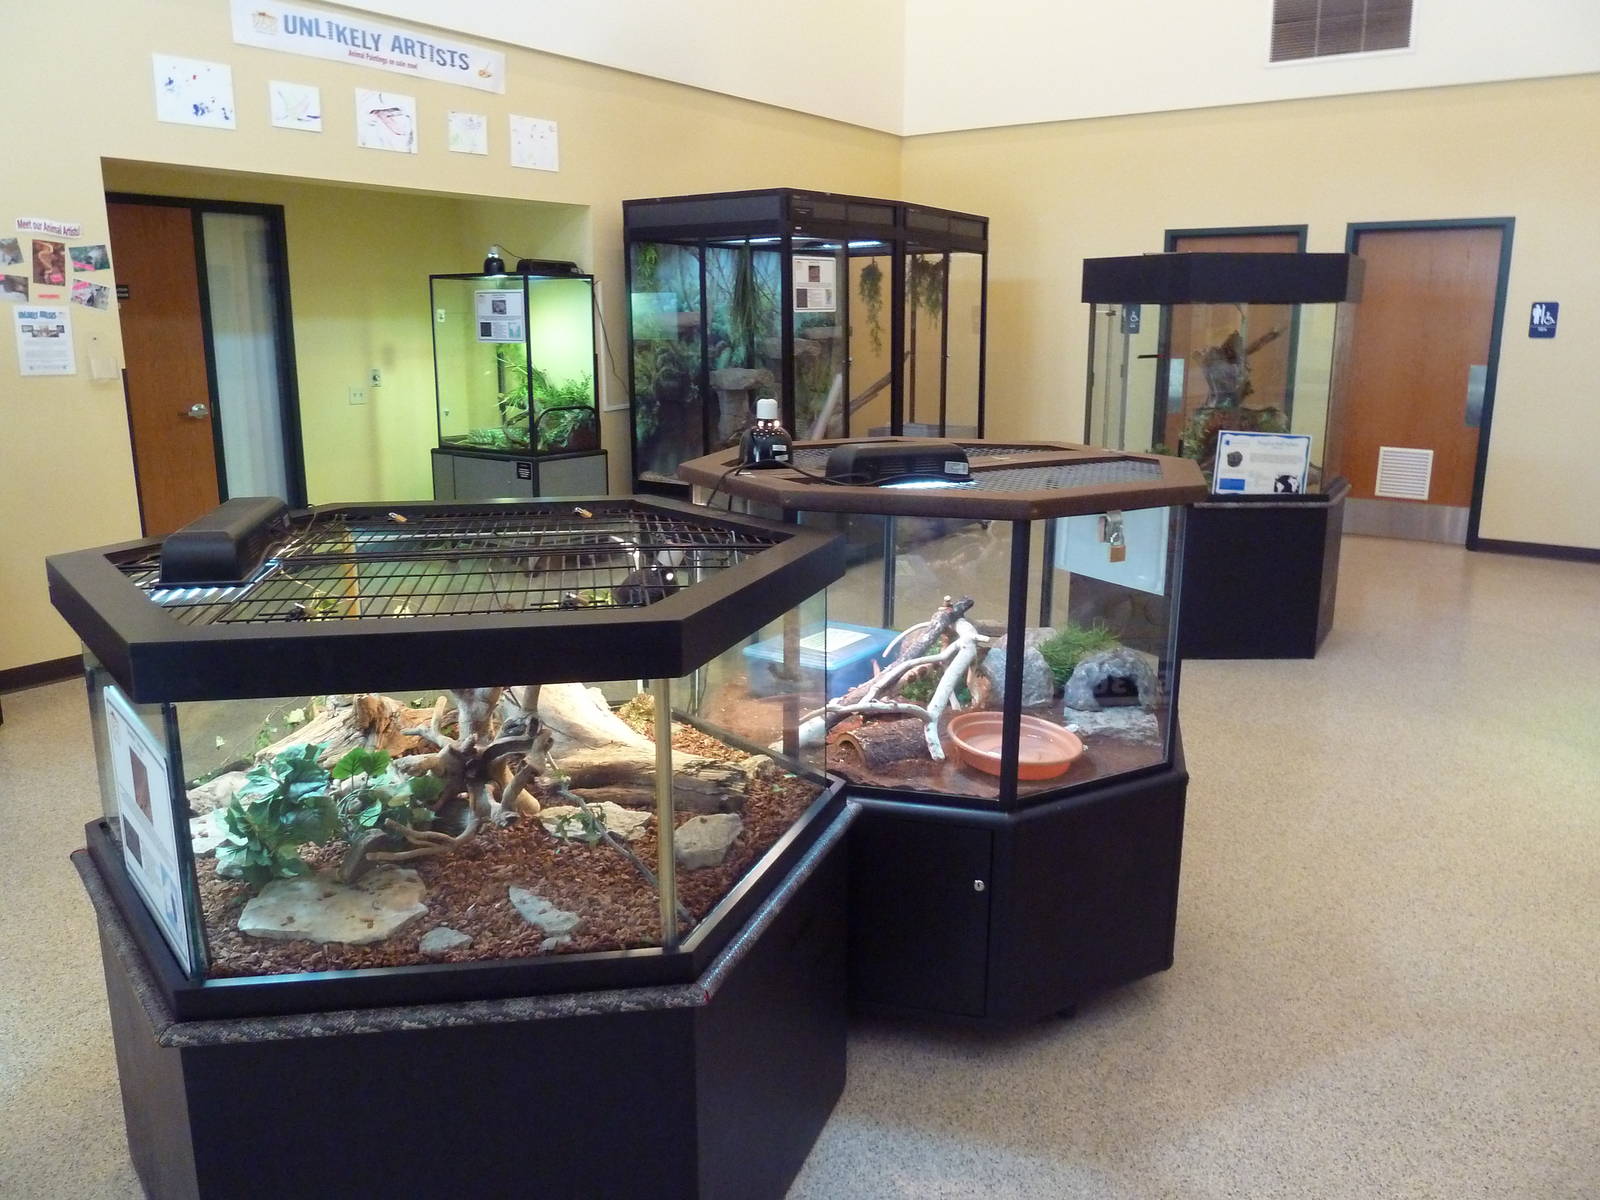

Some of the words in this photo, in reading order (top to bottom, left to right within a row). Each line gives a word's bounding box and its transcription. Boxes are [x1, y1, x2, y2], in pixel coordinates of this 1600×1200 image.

[284, 14, 382, 52] UNLIKELY
[391, 34, 470, 71] ARTISTS
[17, 219, 32, 229] Meet
[33, 222, 42, 230] our
[43, 221, 62, 234] Animal
